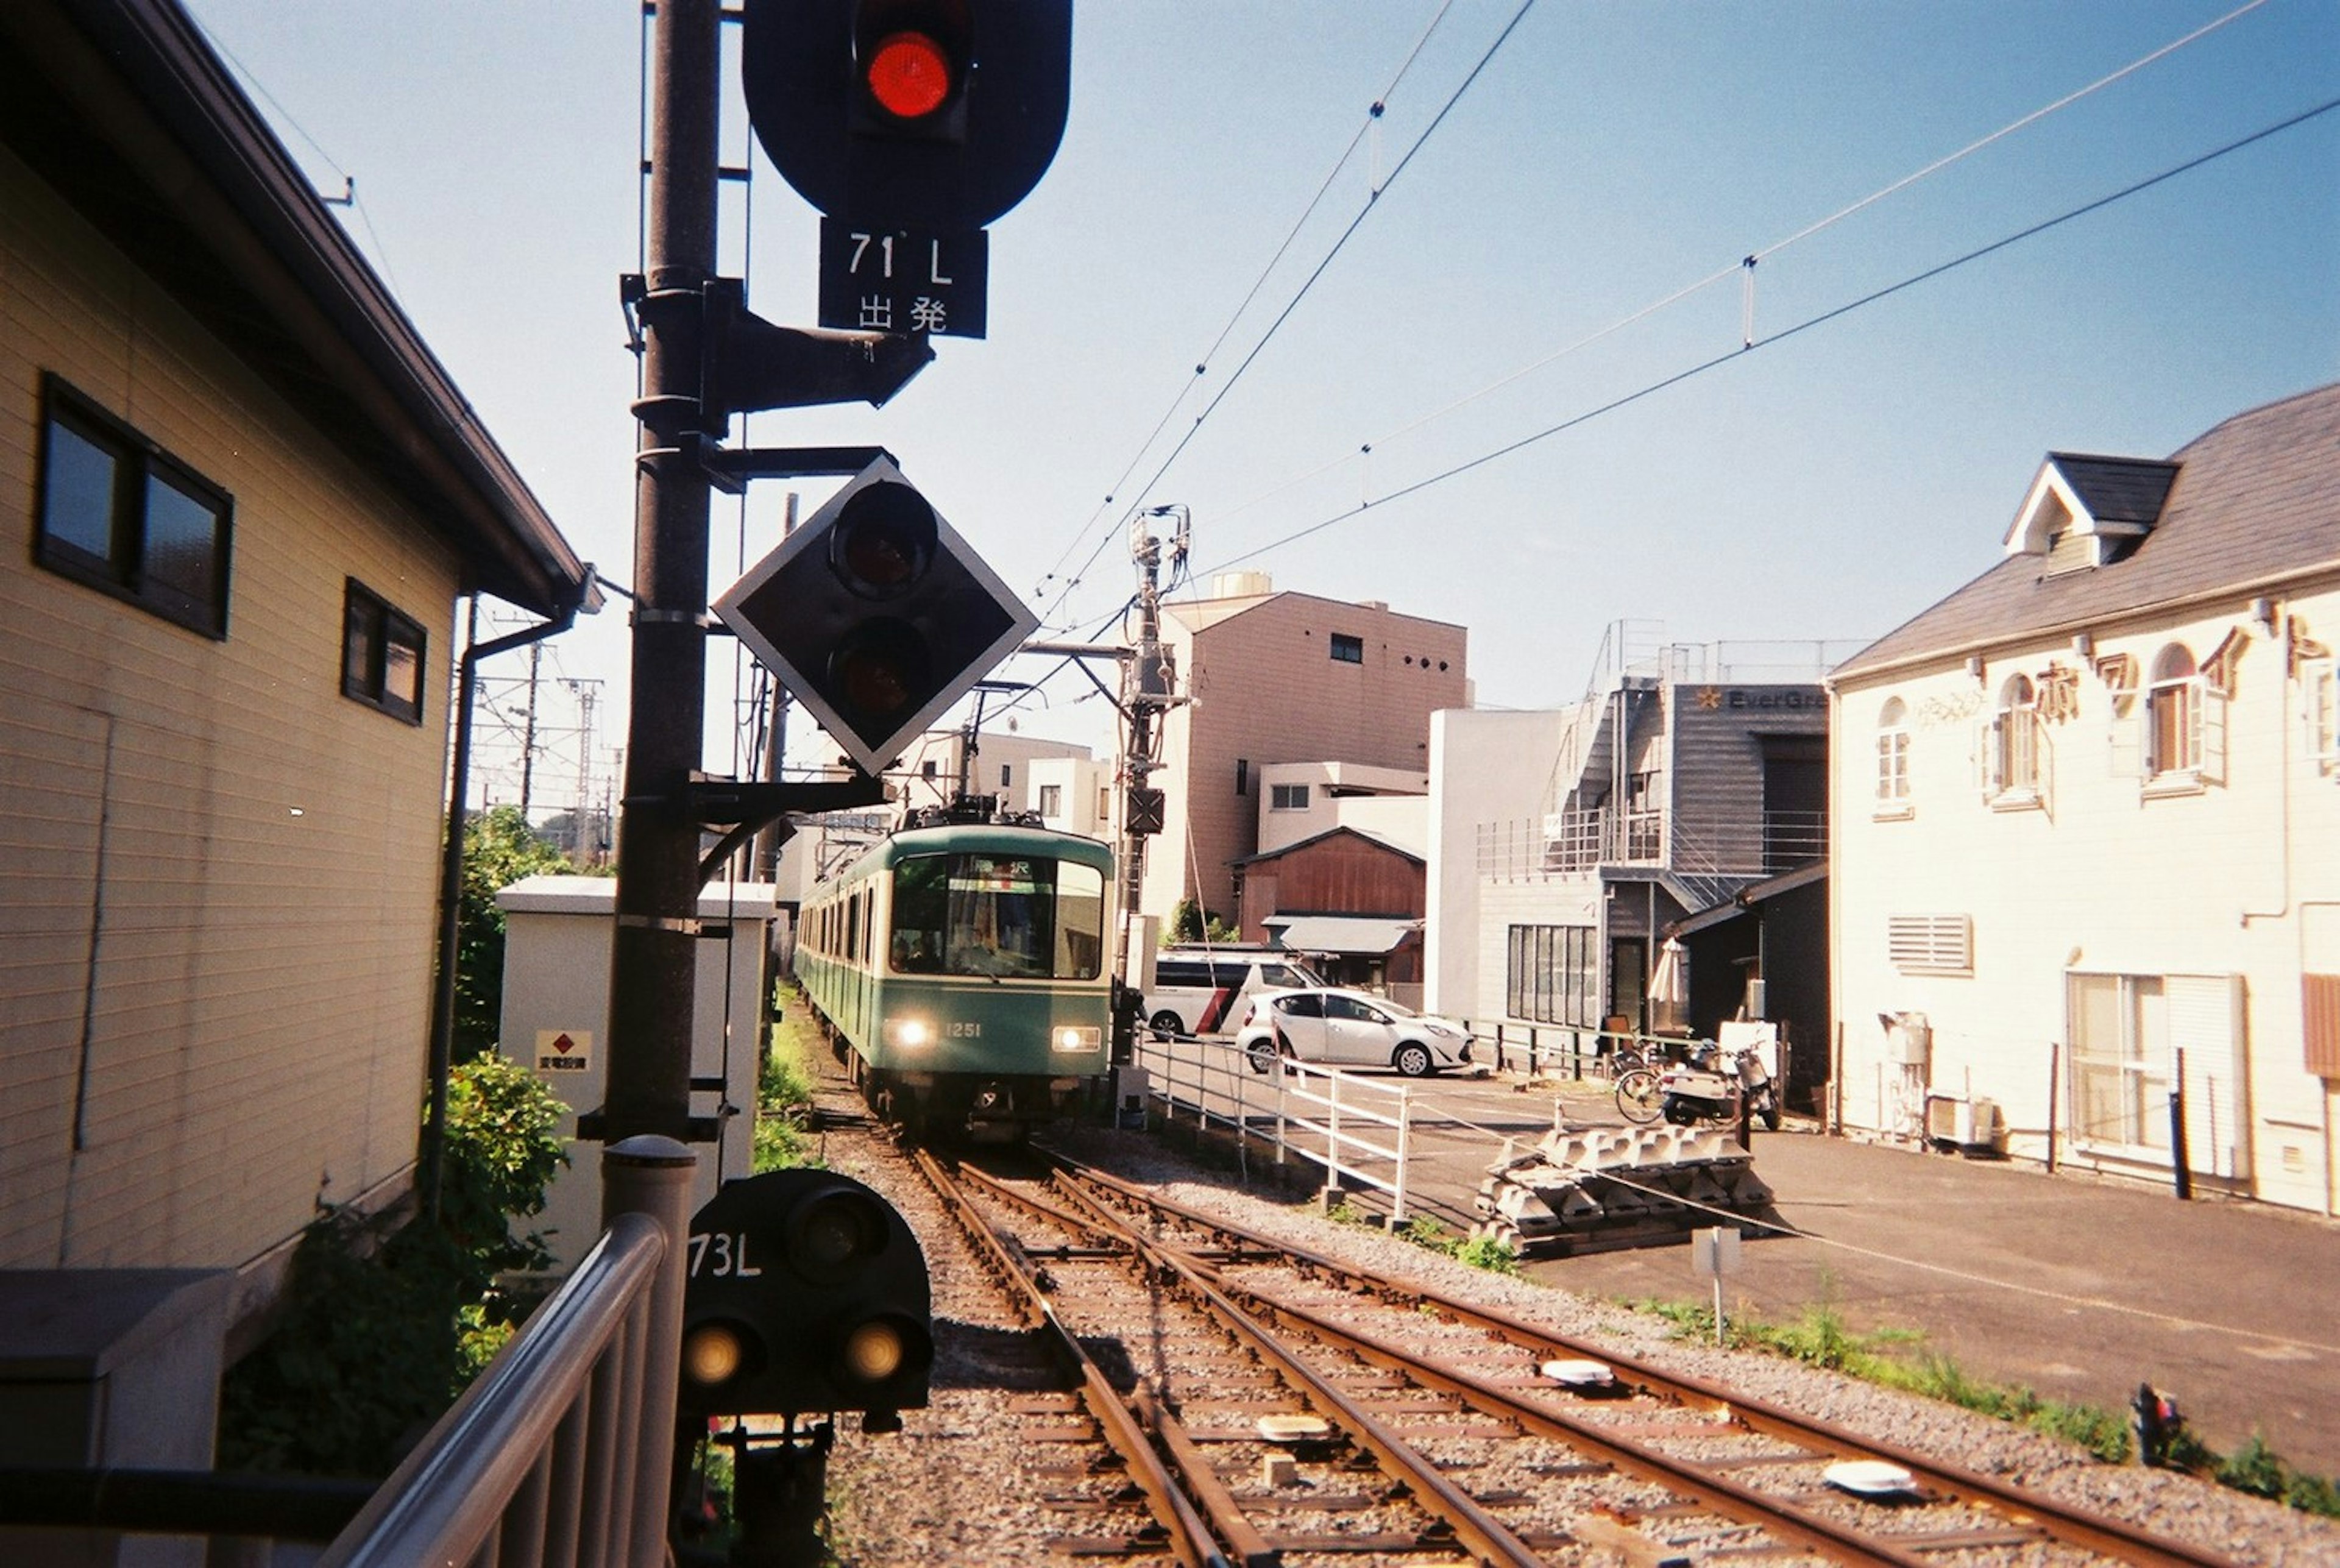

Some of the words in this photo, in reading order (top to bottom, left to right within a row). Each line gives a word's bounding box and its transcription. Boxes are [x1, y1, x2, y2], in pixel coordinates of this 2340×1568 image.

[849, 233, 893, 278] 71
[931, 239, 952, 285] L
[859, 294, 947, 333] 出発
[945, 1022, 981, 1038] 1251
[688, 1232, 762, 1278] 73L
